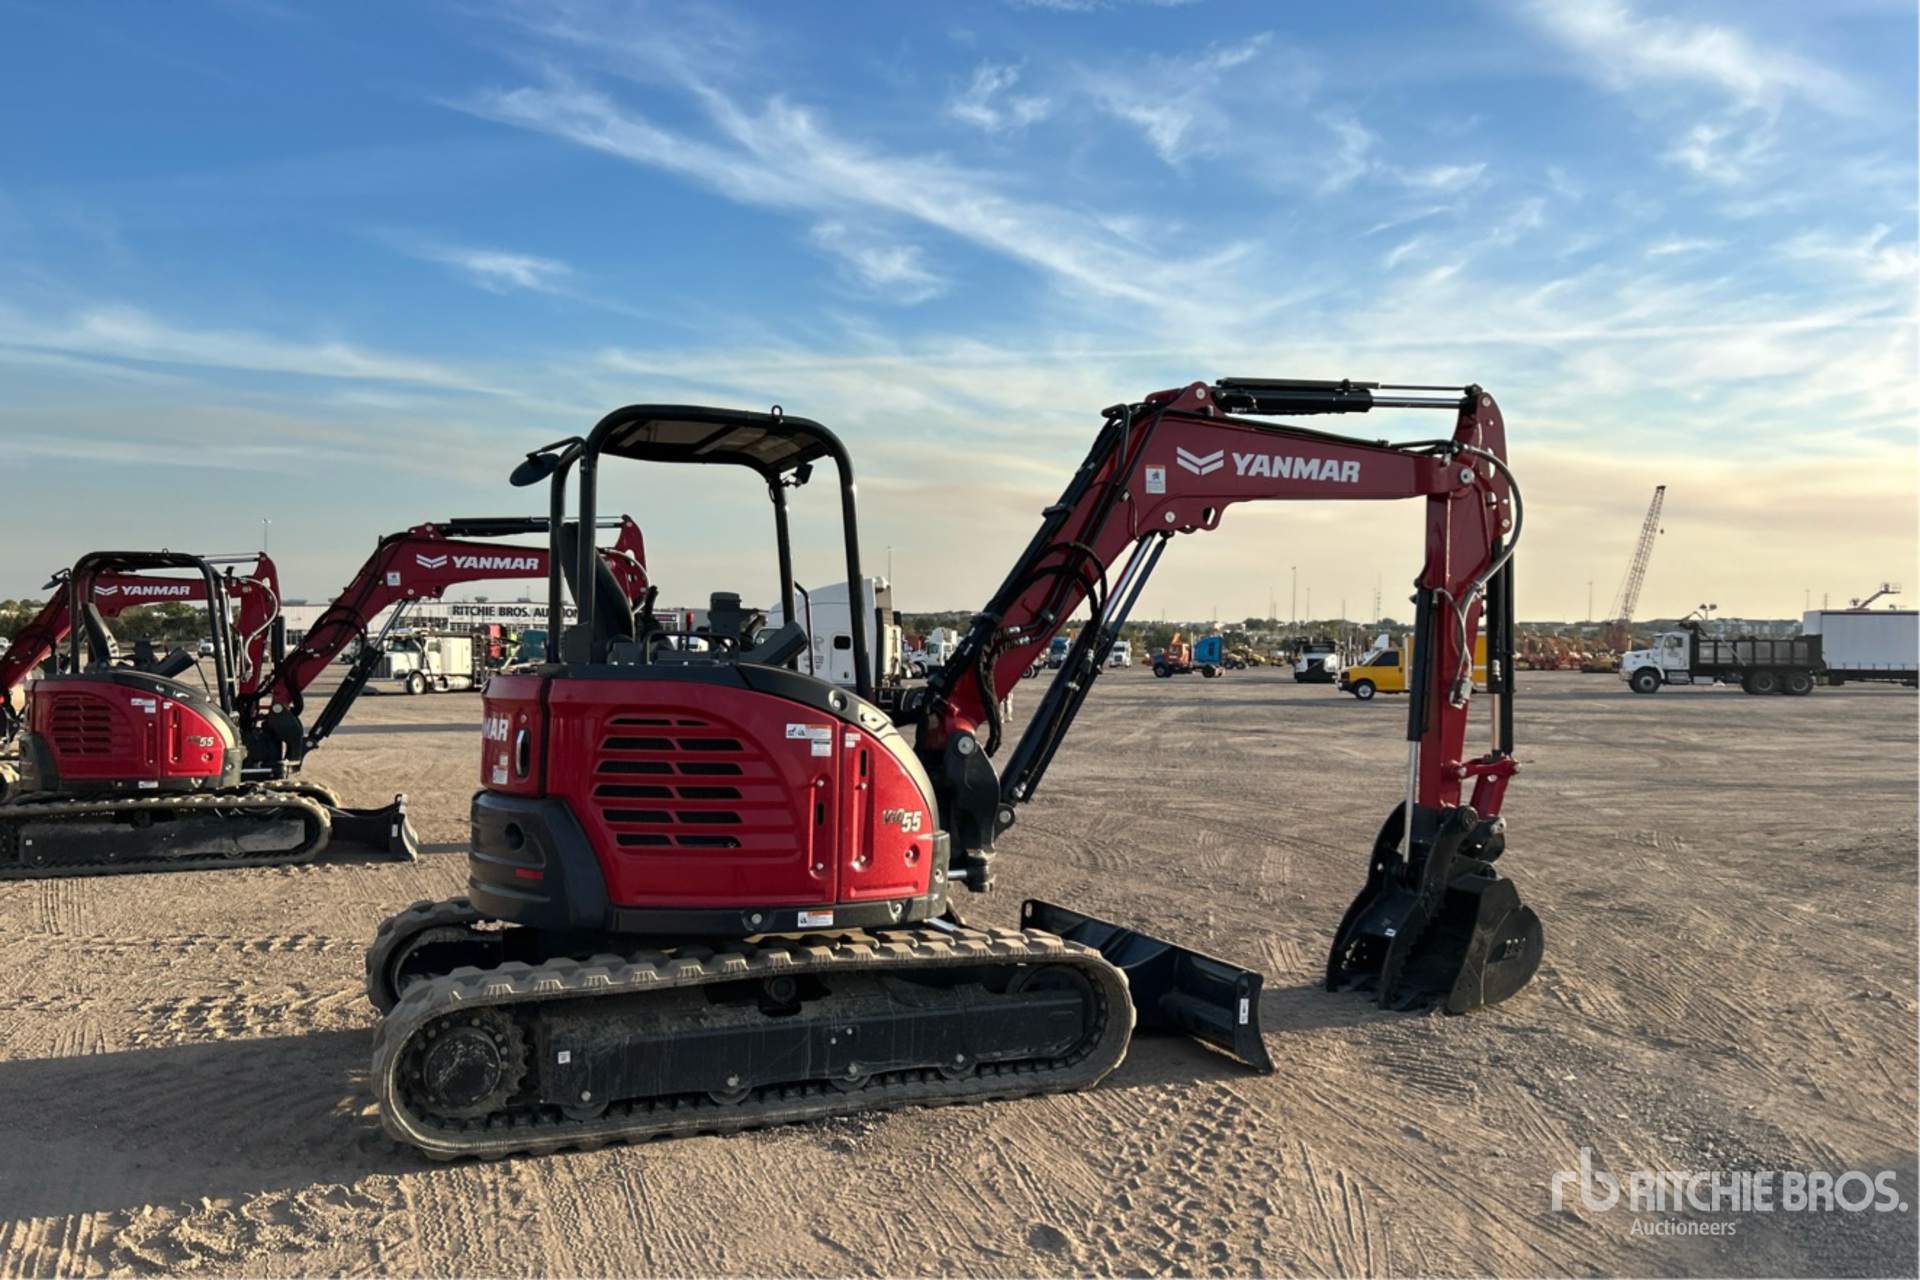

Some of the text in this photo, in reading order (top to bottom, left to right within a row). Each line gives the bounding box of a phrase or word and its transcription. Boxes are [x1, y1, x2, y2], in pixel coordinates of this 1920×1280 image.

[1232, 452, 1361, 483] YANMAR
[452, 555, 539, 570] YANMAR
[122, 585, 191, 596] YANMAR
[452, 605, 496, 617] RITCHIE
[499, 607, 531, 618] BROS.
